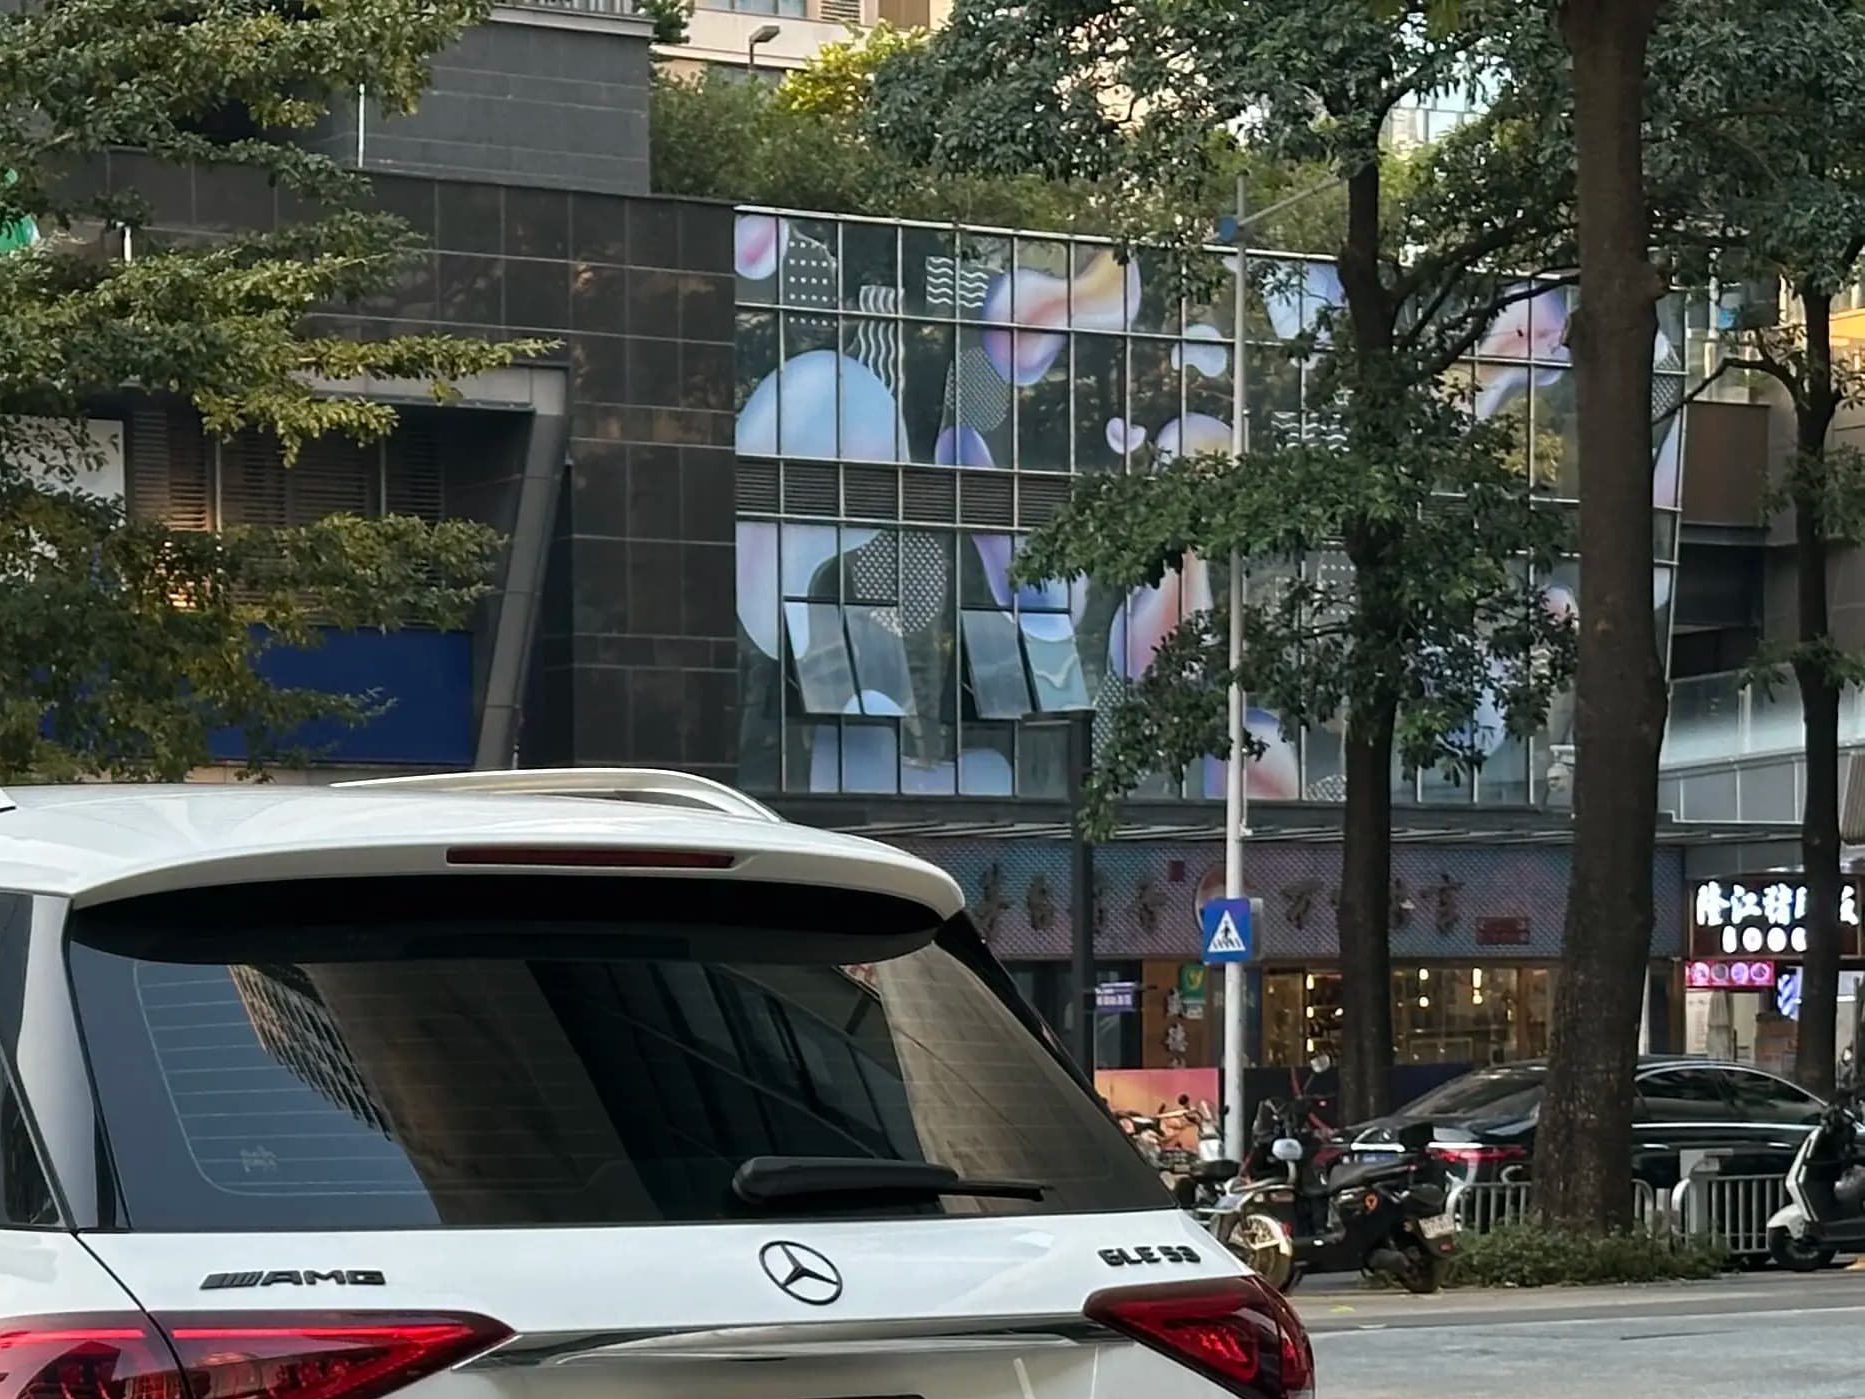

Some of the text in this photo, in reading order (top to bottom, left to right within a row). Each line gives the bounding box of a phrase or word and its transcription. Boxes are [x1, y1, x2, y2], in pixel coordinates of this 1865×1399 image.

[1097, 1245, 1201, 1267] GLE 53
[259, 1269, 386, 1286] AMG
